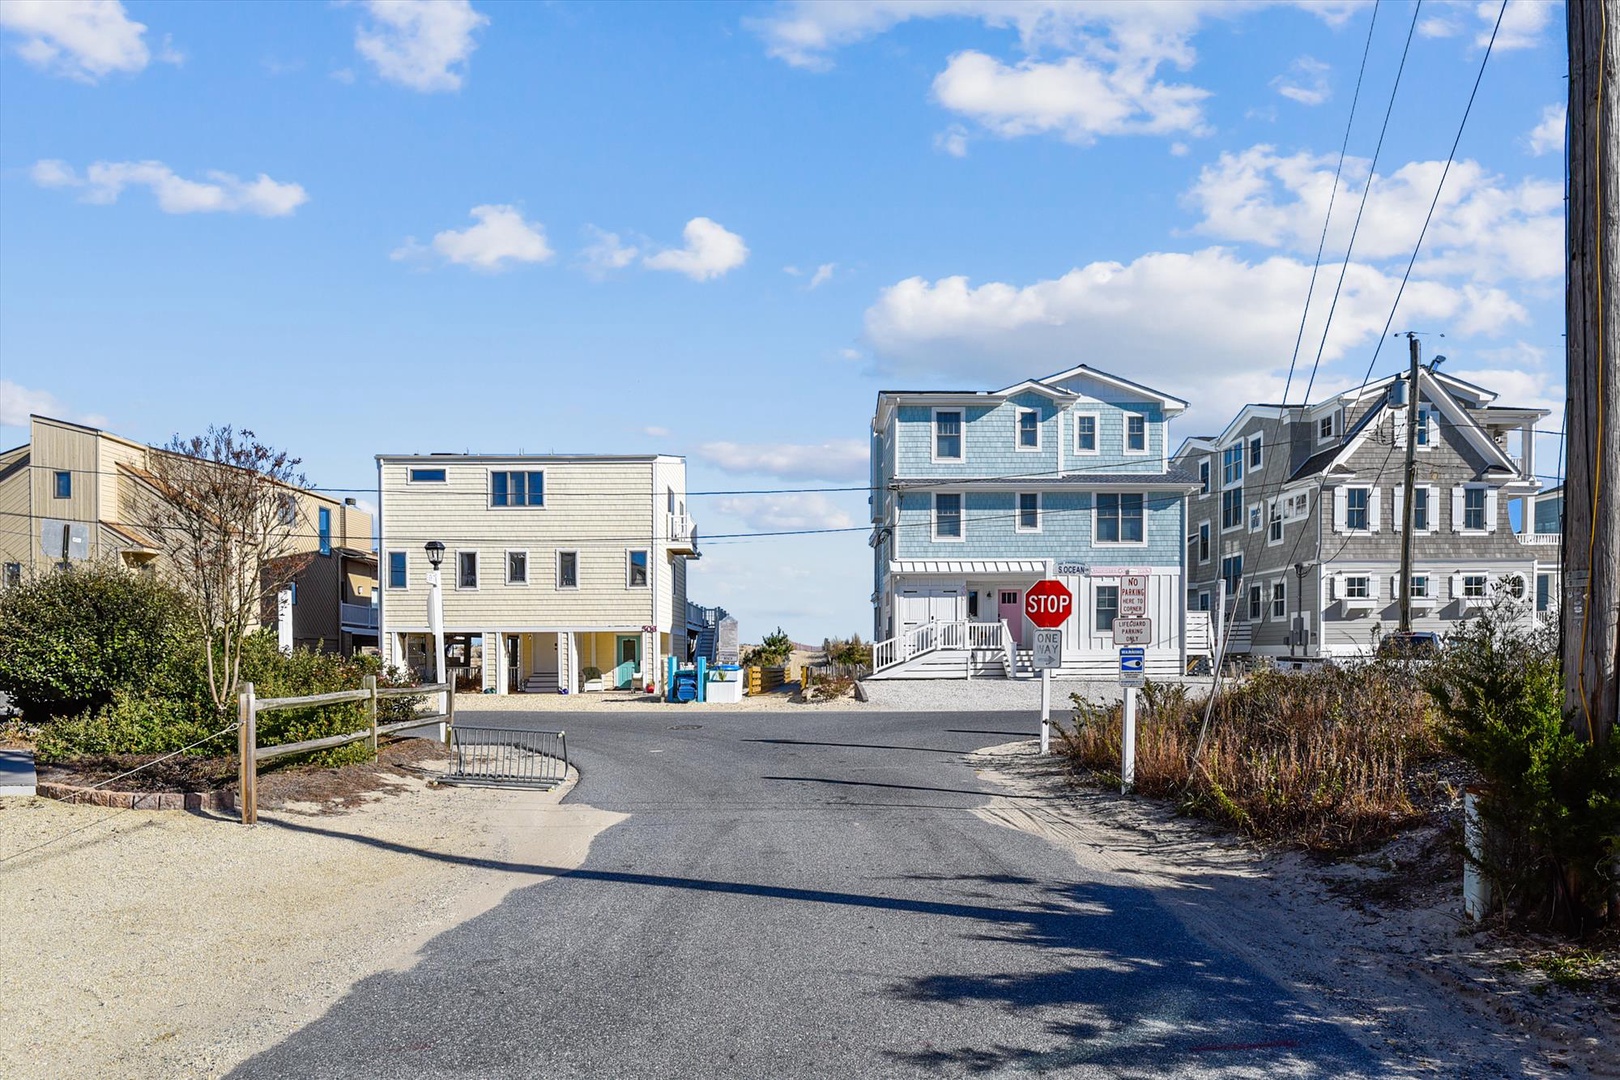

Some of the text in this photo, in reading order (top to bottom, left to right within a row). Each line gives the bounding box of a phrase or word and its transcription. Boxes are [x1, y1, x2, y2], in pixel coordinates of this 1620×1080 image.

[1128, 578, 1138, 586] NO
[1028, 595, 1070, 613] STOP
[1037, 634, 1058, 643] ONE
[1037, 644, 1059, 654] WAY
